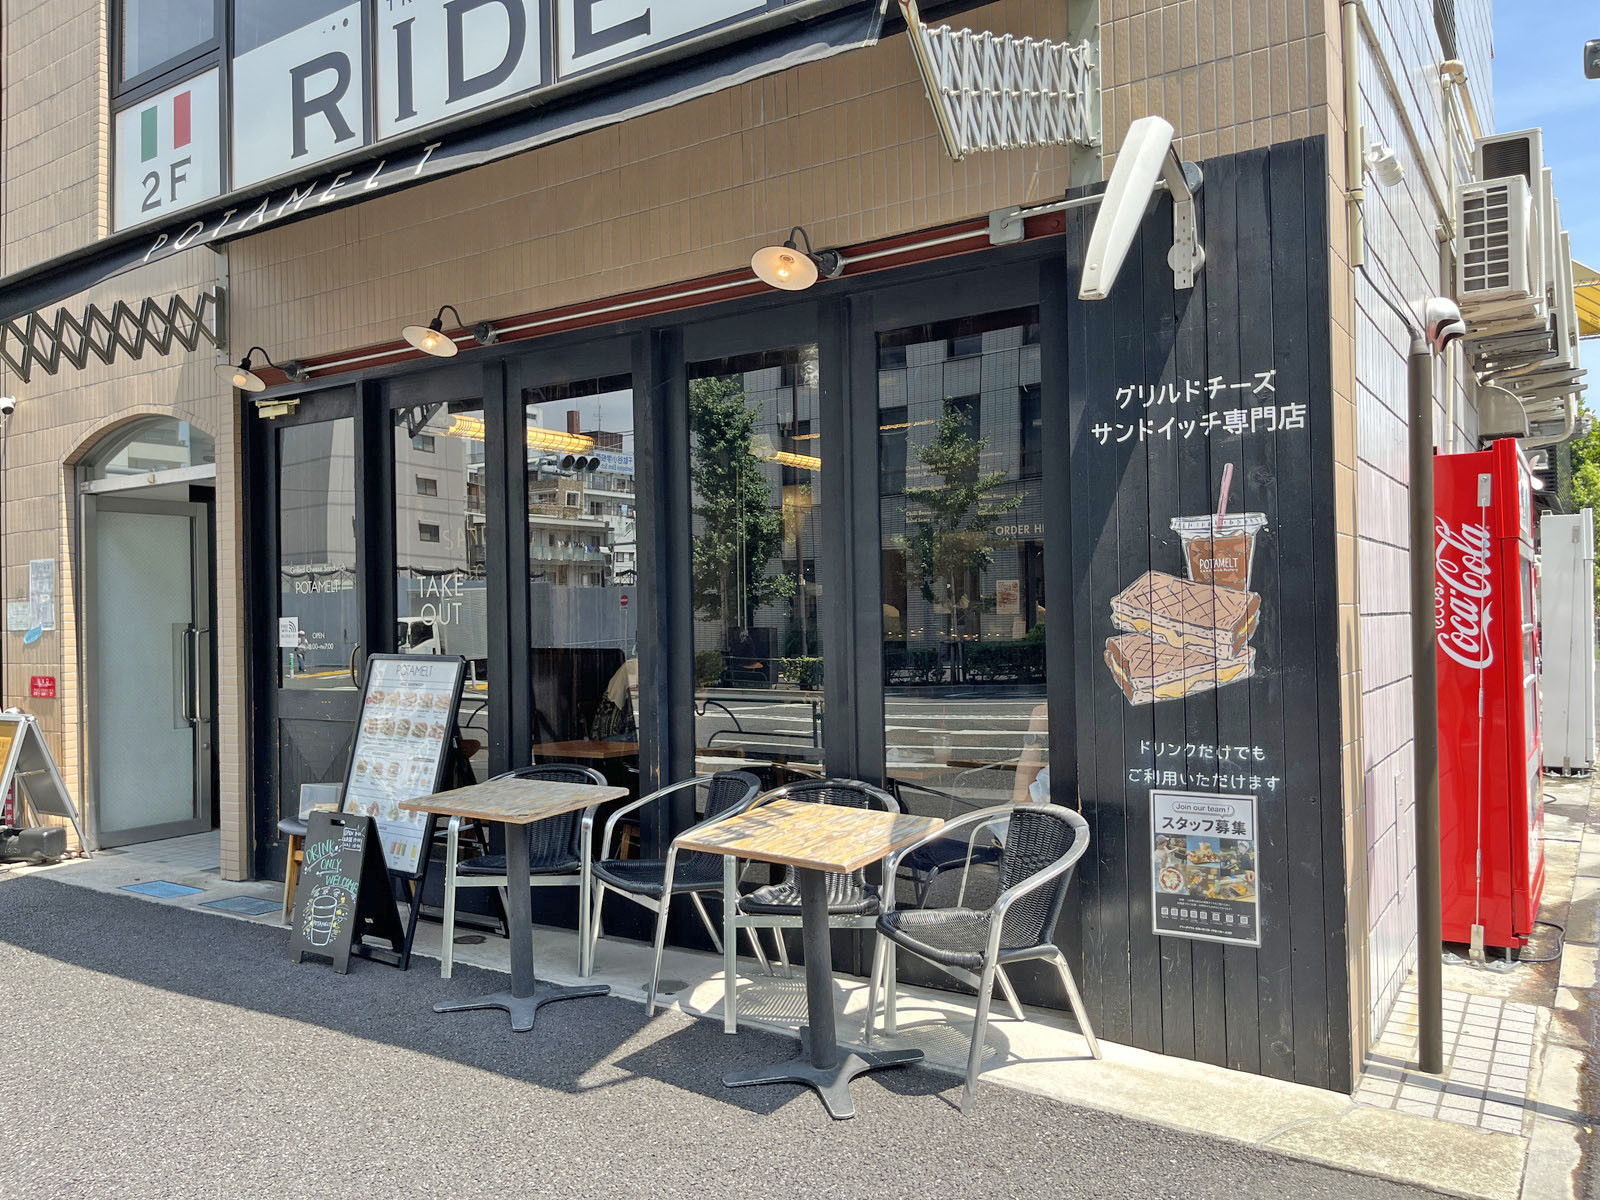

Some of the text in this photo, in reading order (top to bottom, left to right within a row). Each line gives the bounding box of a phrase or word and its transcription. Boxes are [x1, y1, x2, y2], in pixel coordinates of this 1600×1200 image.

[140, 156, 191, 213] 2F
[144, 142, 442, 262] POTAMELT
[1116, 369, 1276, 409] グリルドチーズ
[1091, 402, 1307, 446] サンドイッチ専門店
[995, 524, 1029, 536] ORDER
[1199, 557, 1239, 569] POTAMELT
[295, 579, 339, 594] POTAMELT
[417, 574, 464, 598] TAKE
[1435, 515, 1493, 670] Coca-Cola
[420, 602, 462, 626] OUT
[1140, 739, 1265, 761] ドリンクだけでも
[1128, 767, 1280, 791] ご利用いただけます
[1175, 803, 1192, 811] Join
[1162, 816, 1247, 836] スタッフ募集
[305, 839, 335, 864] DRINK
[320, 858, 342, 874] ONLY
